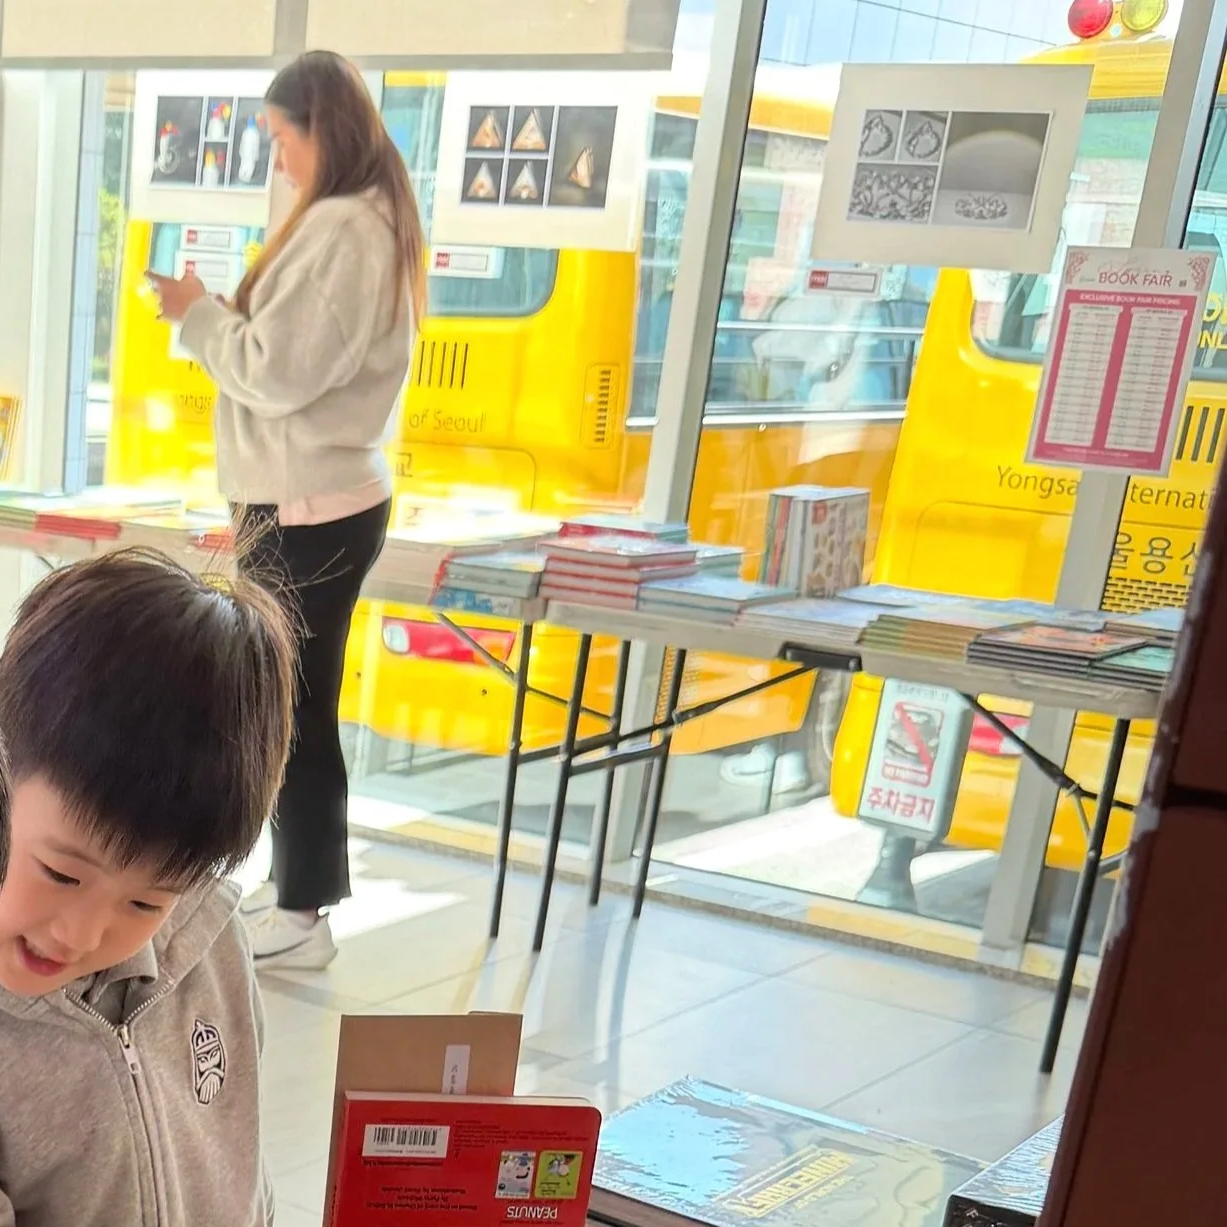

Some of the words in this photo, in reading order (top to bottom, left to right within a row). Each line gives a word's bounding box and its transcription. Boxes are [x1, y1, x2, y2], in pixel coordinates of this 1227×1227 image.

[1098, 271, 1139, 286] BOOK
[1143, 271, 1173, 287] FAIR
[409, 409, 426, 428] of
[432, 410, 486, 433] Seoul
[997, 466, 1081, 499] Yongsa
[866, 786, 935, 823] 주차금지
[506, 1204, 556, 1219] PEANUTS
